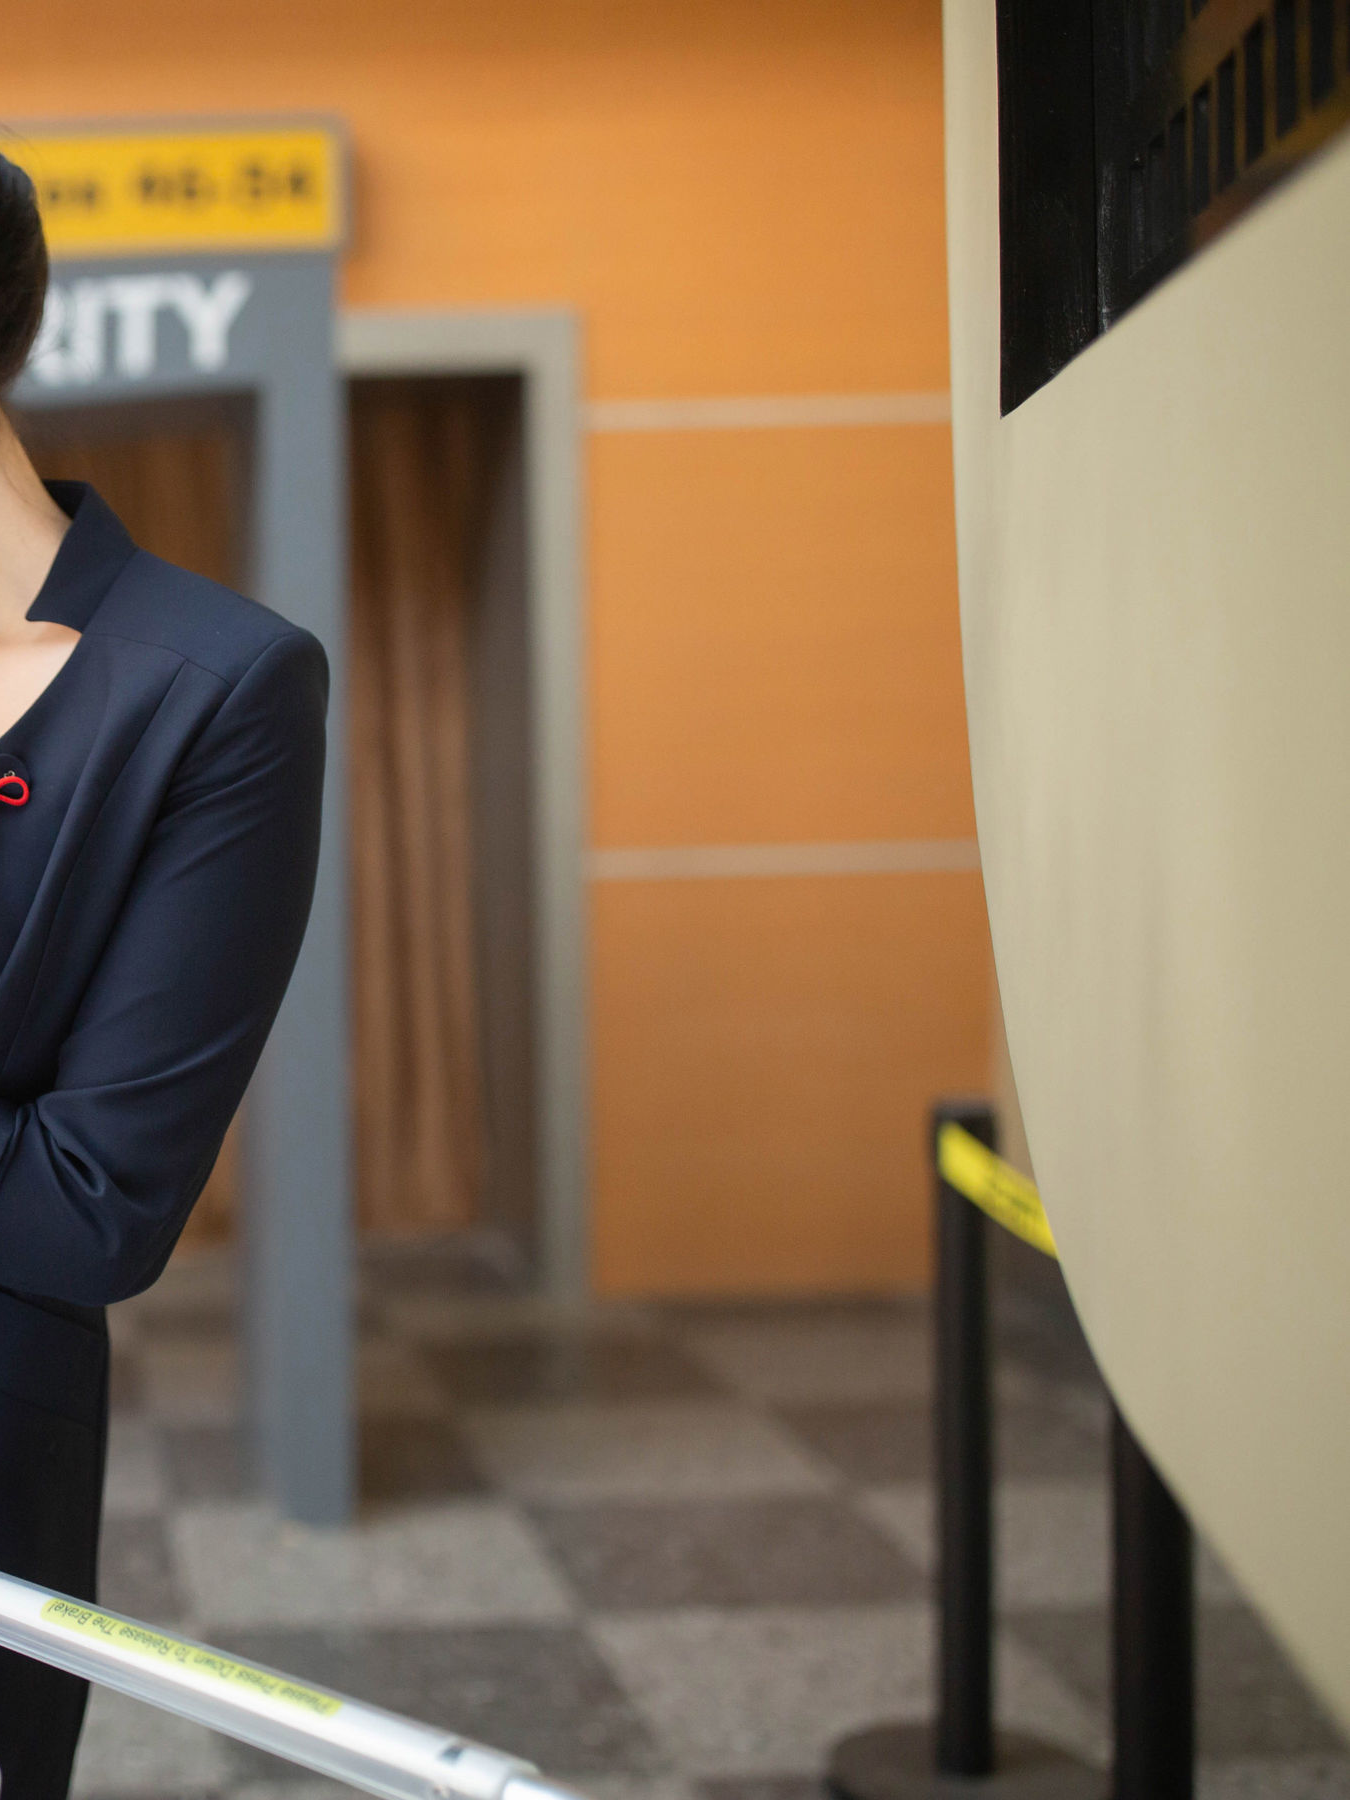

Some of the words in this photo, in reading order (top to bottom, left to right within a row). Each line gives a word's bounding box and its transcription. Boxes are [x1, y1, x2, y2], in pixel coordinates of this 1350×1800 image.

[47, 1600, 92, 1625] Brake!
[92, 1615, 116, 1636] The
[119, 1626, 172, 1656] Release
[174, 1646, 191, 1663] To
[193, 1654, 234, 1678] Down
[235, 1669, 276, 1694] Press
